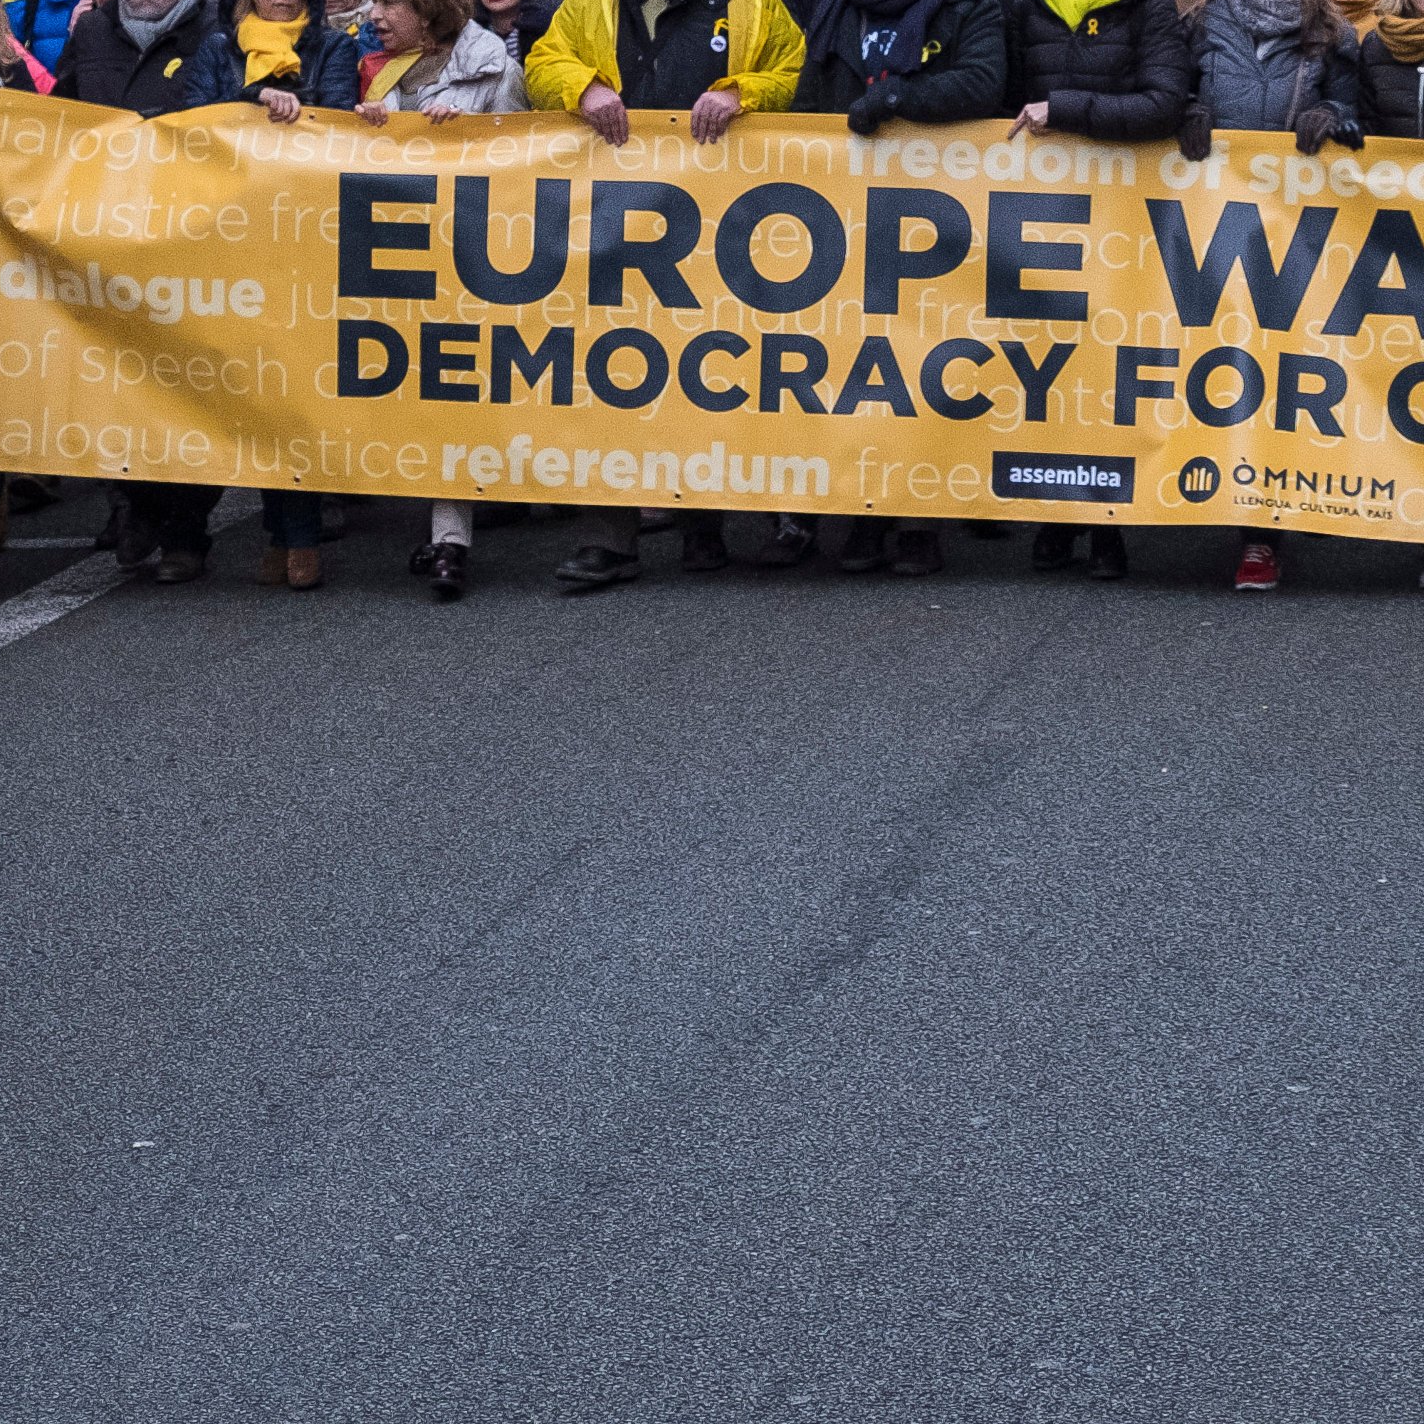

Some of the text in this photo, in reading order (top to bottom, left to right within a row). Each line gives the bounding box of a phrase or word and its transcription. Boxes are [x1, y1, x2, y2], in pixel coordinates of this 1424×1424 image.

[231, 119, 437, 172] justice
[459, 121, 833, 176] referendum
[847, 128, 1137, 186] freedom
[1159, 139, 1231, 191] of
[53, 190, 249, 246] justice
[338, 172, 1092, 322] EUROPE
[79, 345, 288, 398] speech
[337, 319, 1079, 423] DEMOCRACY
[1113, 345, 1347, 438] FOR
[229, 422, 430, 481] justice
[441, 432, 831, 496] referendum
[854, 446, 1001, 503] free
[1008, 464, 1122, 488] assemblea
[1232, 456, 1396, 500] ÒMNIUM
[1233, 495, 1293, 511] LLENGUA
[1299, 501, 1361, 518] CULTURA
